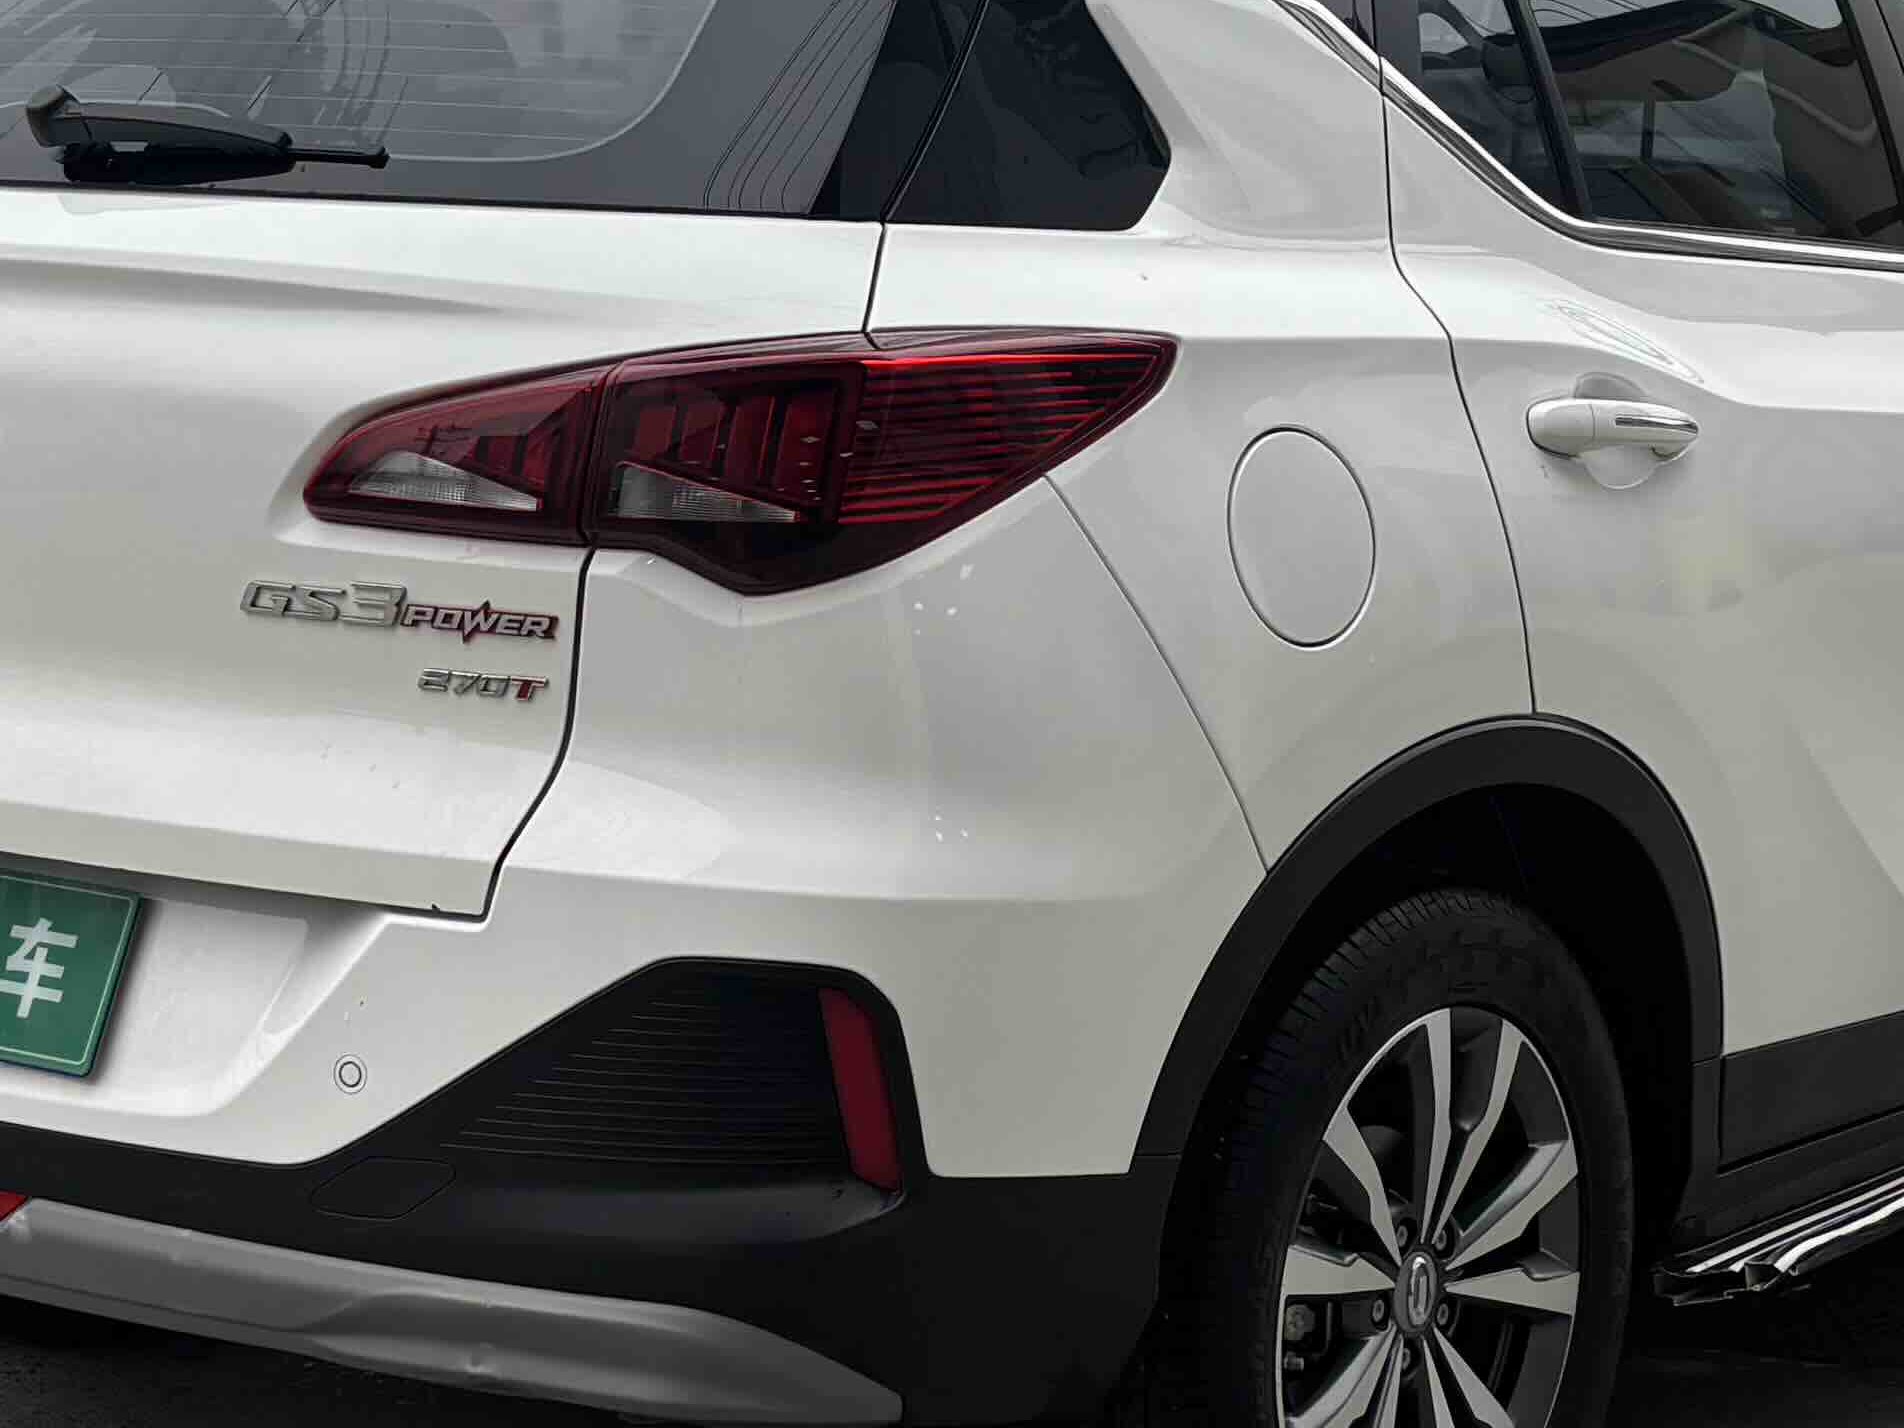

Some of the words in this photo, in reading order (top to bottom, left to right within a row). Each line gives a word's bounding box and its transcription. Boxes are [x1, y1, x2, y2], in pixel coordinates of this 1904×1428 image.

[240, 580, 407, 627] GS3
[400, 600, 559, 644] POWER
[418, 667, 549, 700] 270T
